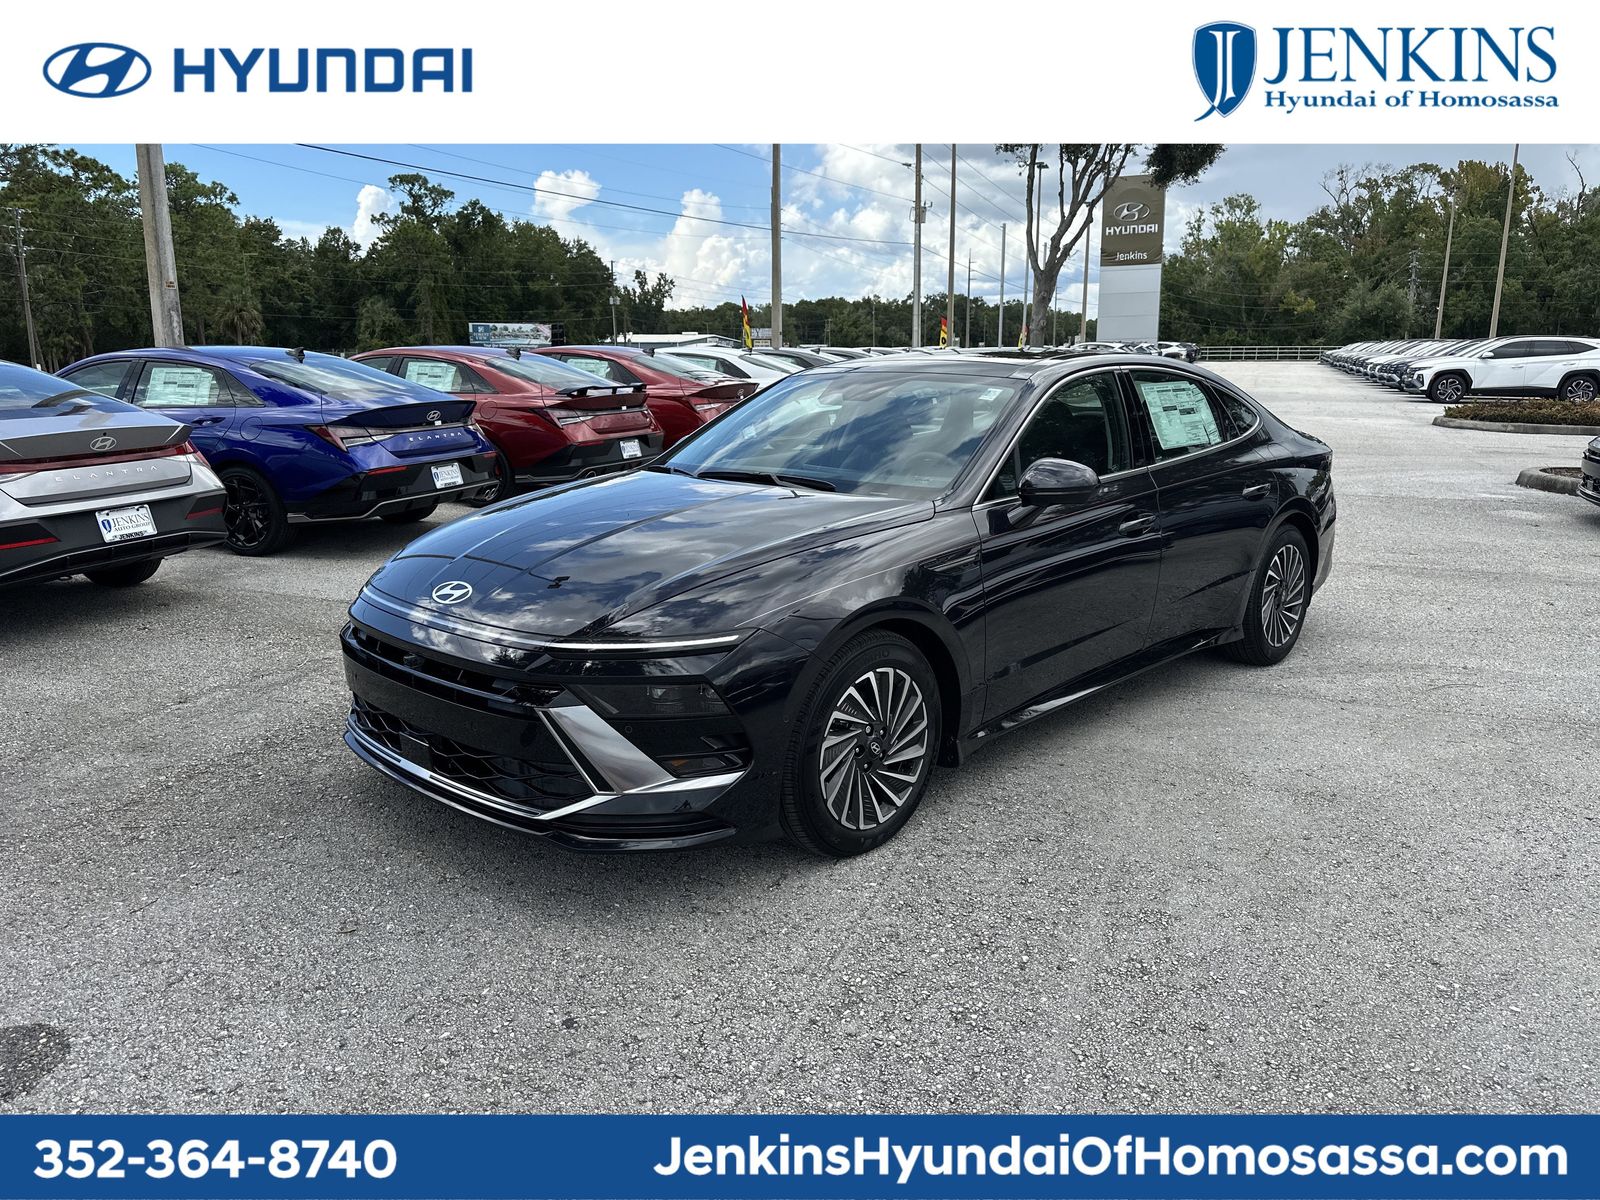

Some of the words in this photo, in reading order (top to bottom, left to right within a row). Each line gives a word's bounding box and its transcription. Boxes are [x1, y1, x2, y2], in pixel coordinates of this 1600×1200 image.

[1105, 223, 1158, 236] HYUNDAI
[1115, 251, 1148, 261] Jenkins
[409, 432, 462, 441] ELANTRA
[55, 465, 158, 481] ELANTRA
[112, 513, 151, 527] JENKINS
